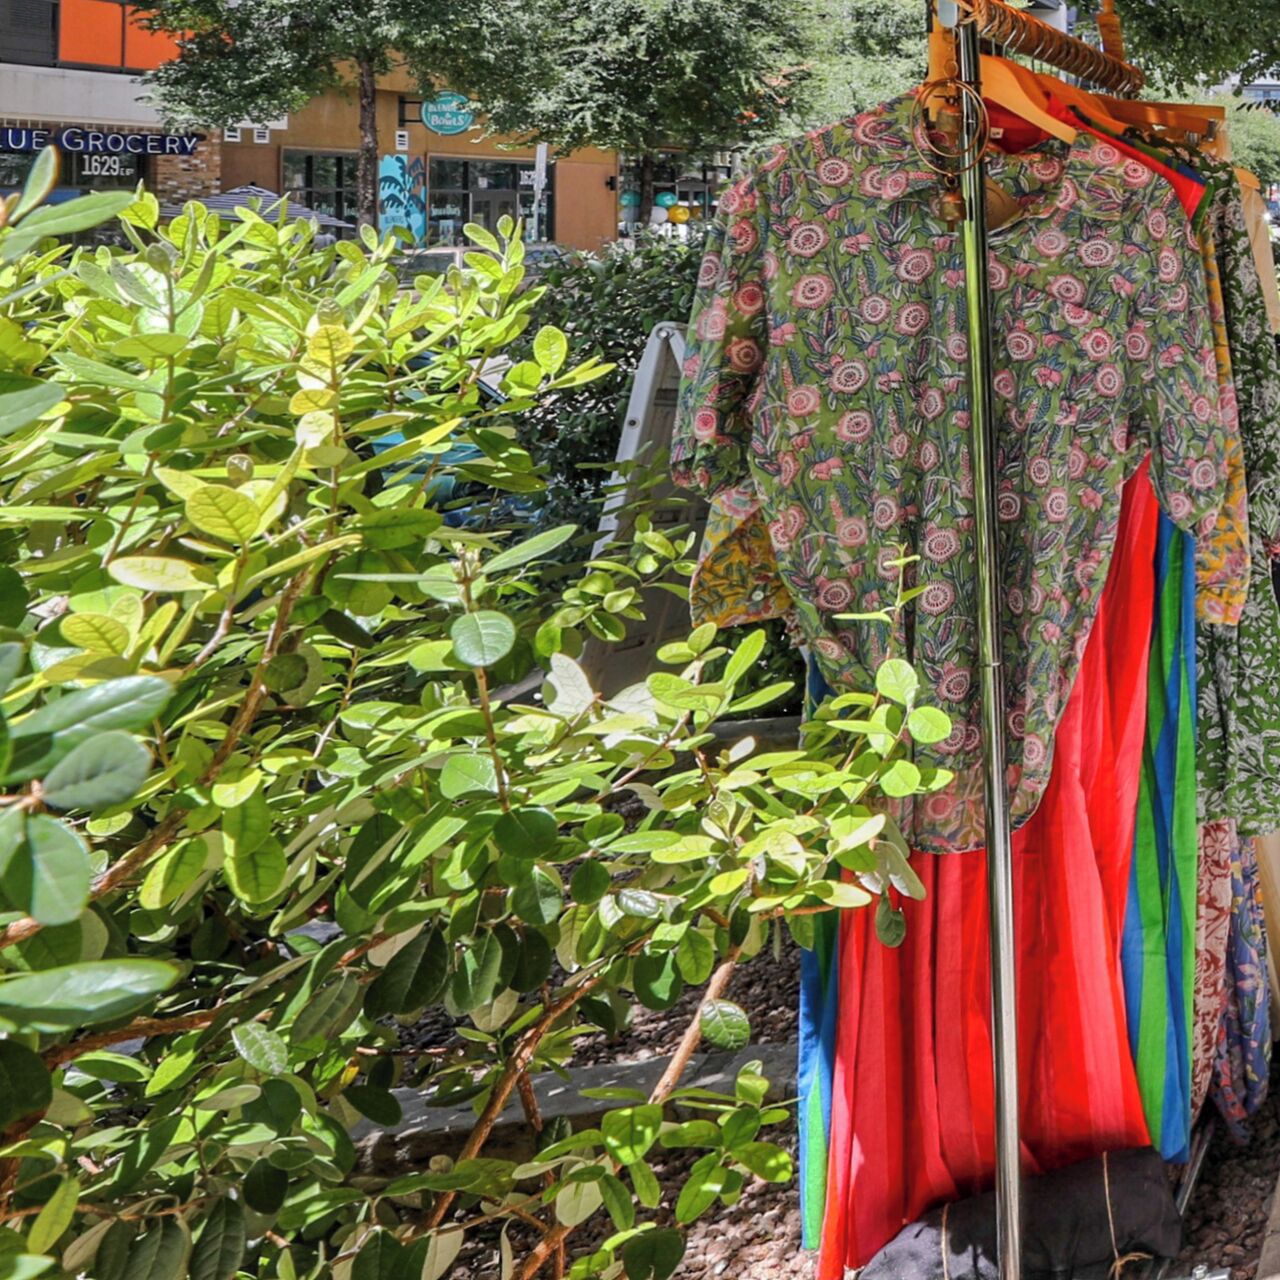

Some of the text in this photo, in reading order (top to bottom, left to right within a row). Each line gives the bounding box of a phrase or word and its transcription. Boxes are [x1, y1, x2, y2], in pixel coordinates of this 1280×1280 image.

[431, 114, 465, 126] BOWLS
[0, 128, 197, 154] UE GROCERY
[81, 154, 120, 176] 1629
